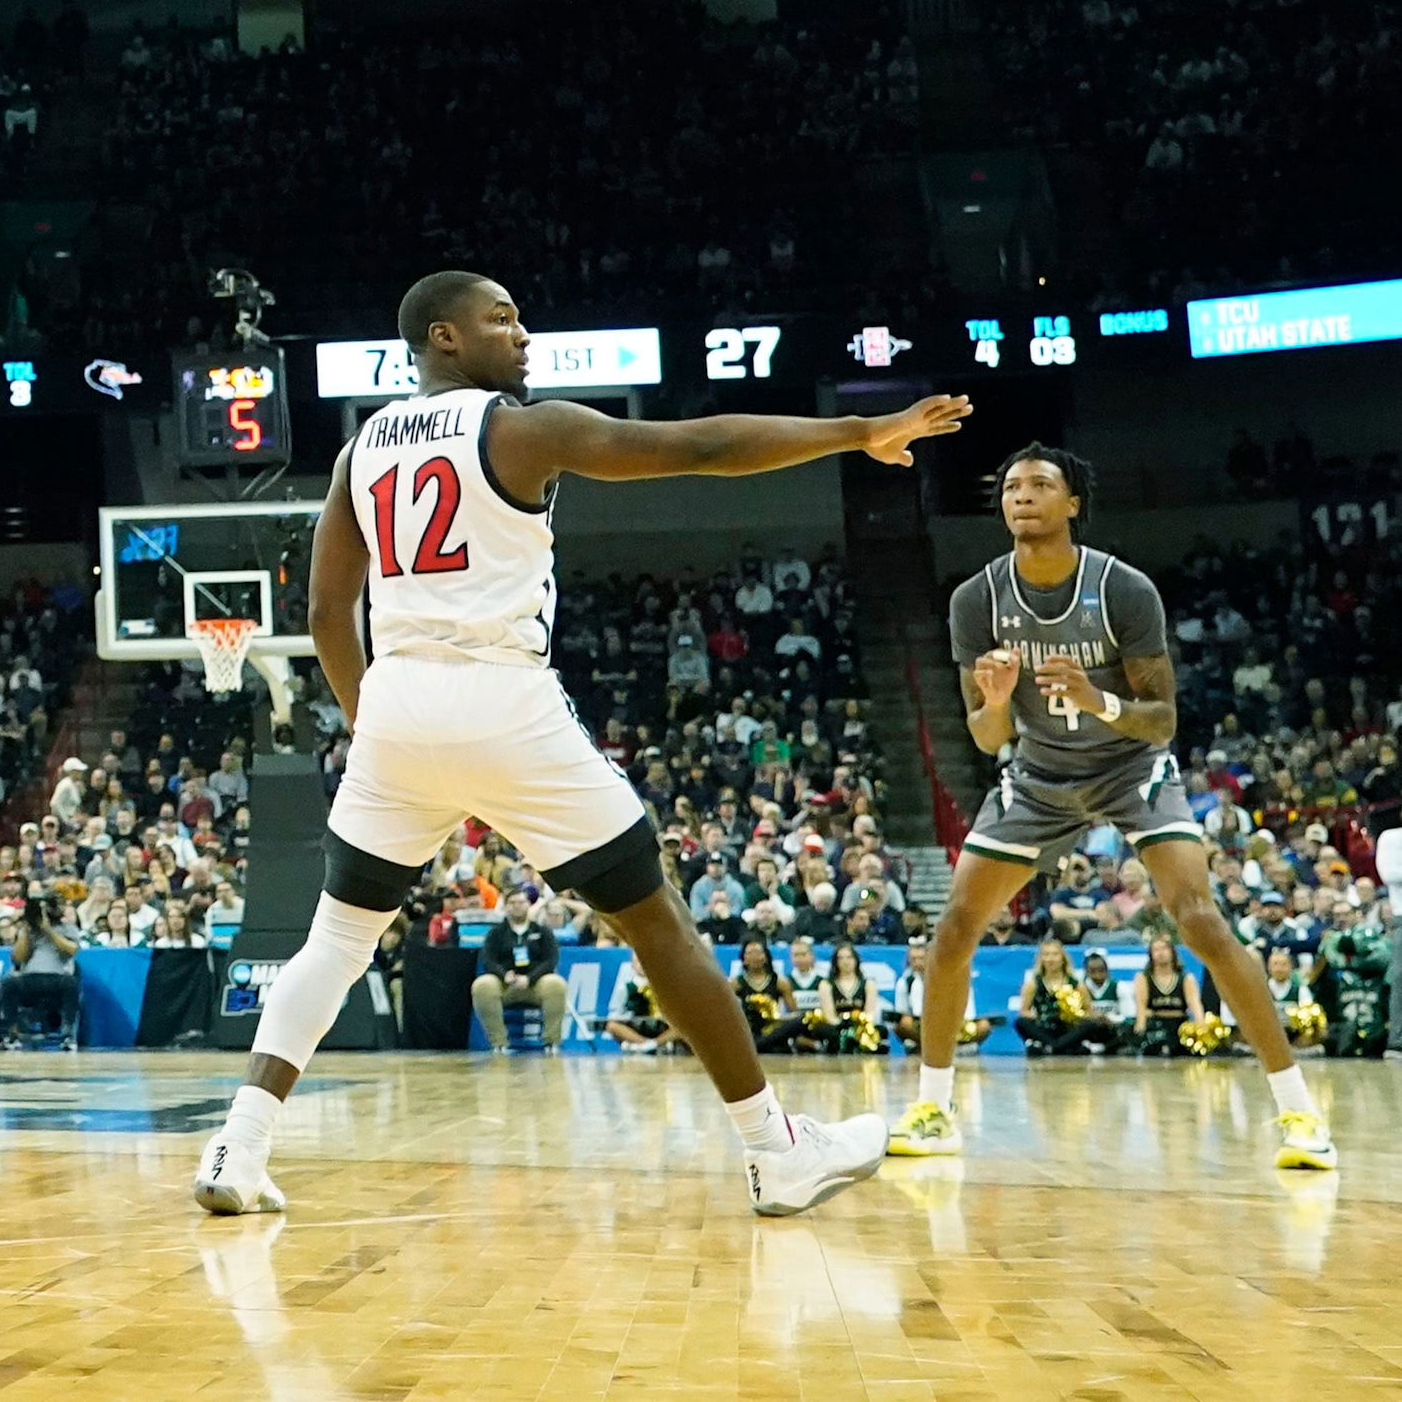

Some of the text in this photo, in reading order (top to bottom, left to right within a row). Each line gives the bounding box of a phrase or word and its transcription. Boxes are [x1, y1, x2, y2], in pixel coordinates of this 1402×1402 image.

[965, 319, 1004, 341] TOL
[1216, 300, 1258, 325] TCU
[1030, 336, 1076, 366] 03
[1218, 324, 1276, 352] UTAH
[1282, 314, 1351, 346] STATE
[551, 348, 595, 372] 1ST
[705, 326, 781, 379] 27
[975, 340, 1000, 368] 4
[229, 398, 261, 451] 5
[366, 407, 465, 448] TRAMMELL
[368, 456, 469, 578] 12
[1048, 682, 1081, 731] 4
